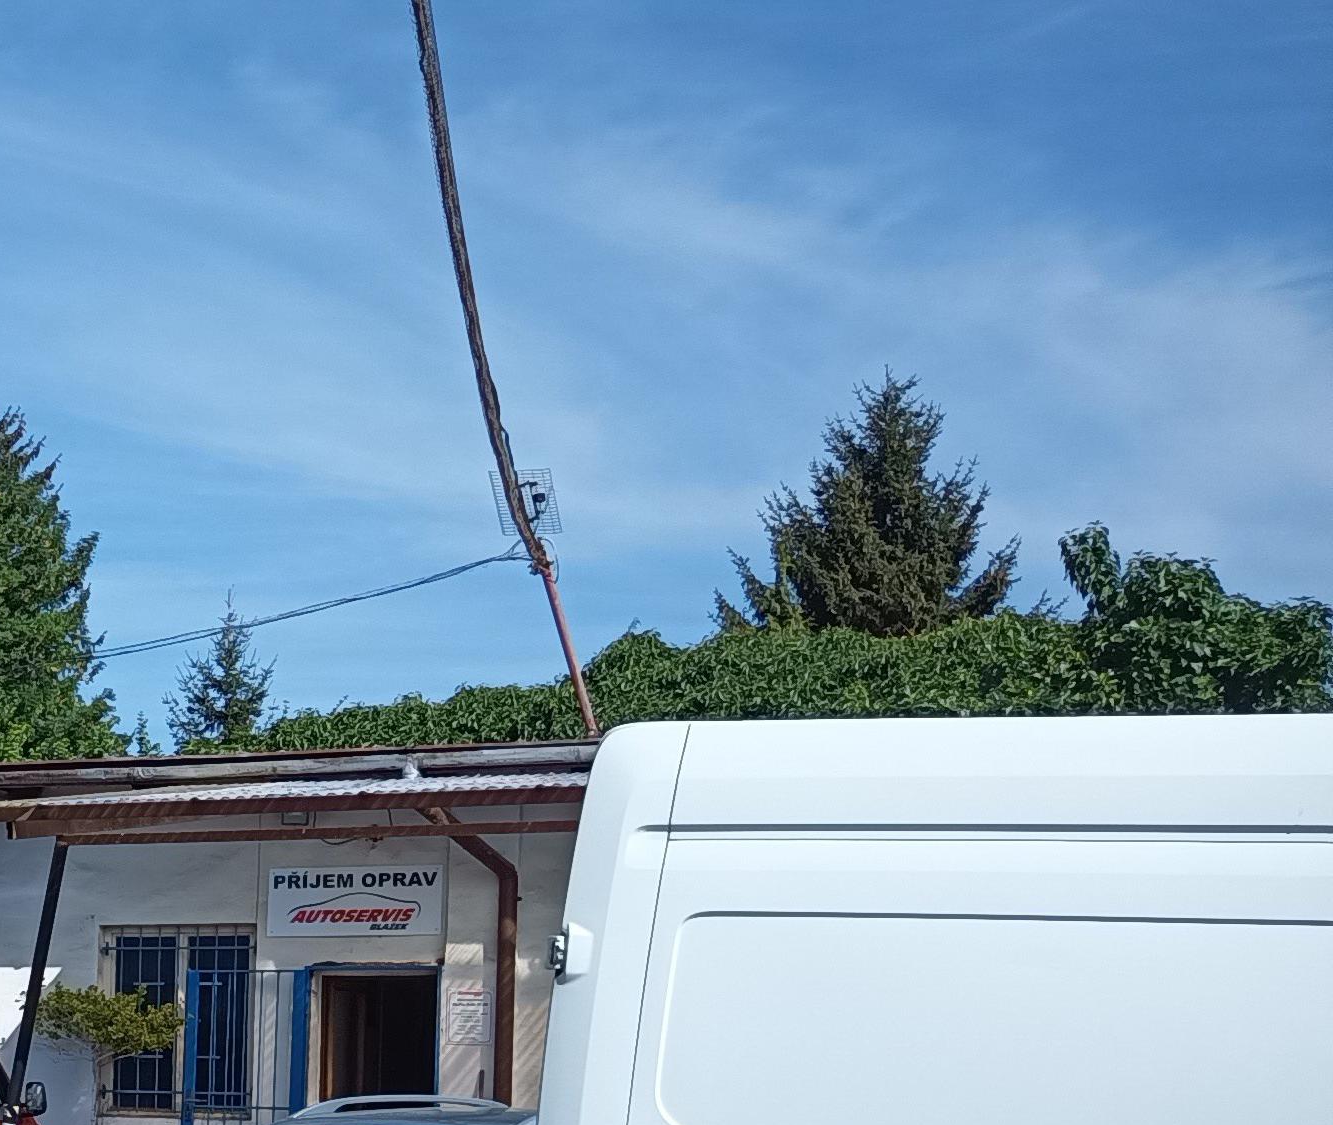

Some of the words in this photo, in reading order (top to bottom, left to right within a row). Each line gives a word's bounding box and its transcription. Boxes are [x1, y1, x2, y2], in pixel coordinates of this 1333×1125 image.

[273, 871, 354, 890] PŘÍJEM
[361, 872, 438, 888] OPRAV
[290, 908, 415, 924] AUTOSERVIS
